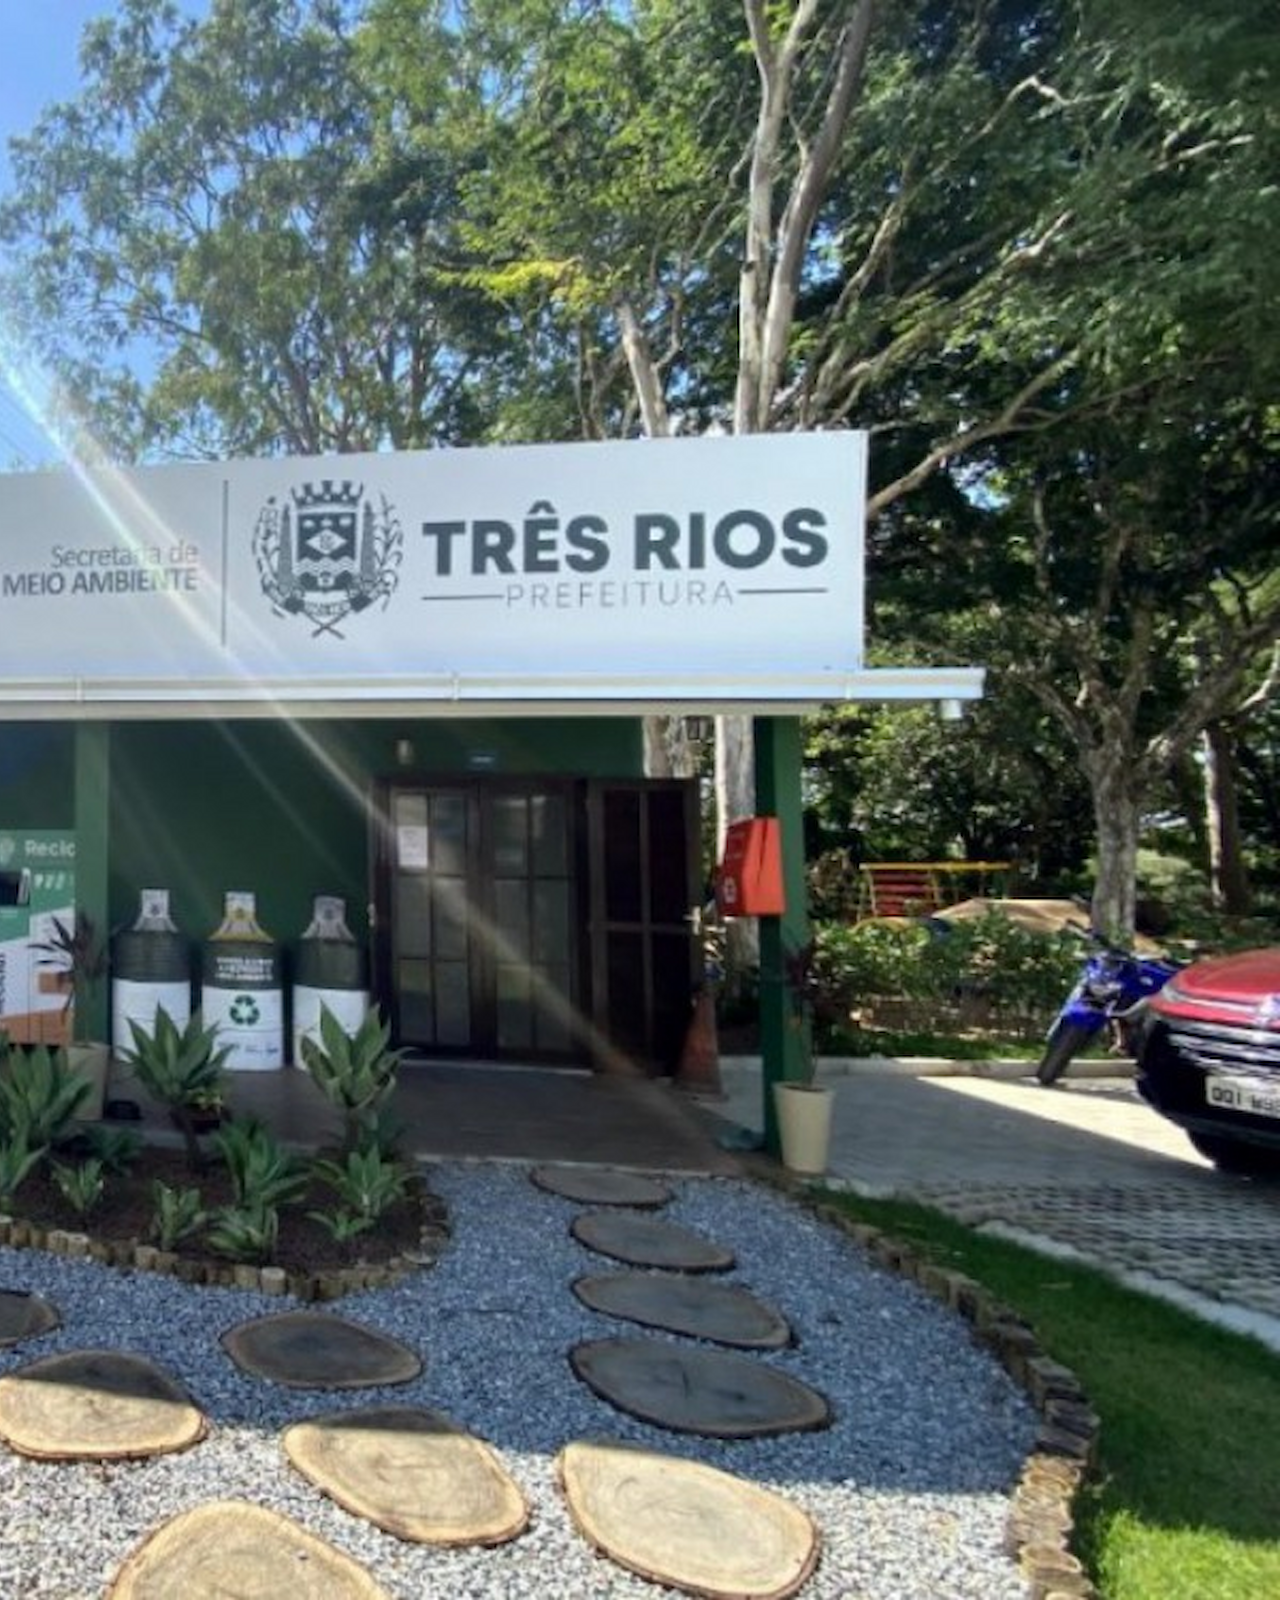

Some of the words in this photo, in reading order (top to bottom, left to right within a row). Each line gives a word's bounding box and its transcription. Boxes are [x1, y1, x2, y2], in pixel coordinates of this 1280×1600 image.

[422, 500, 610, 577] TRÊS
[634, 507, 829, 571] RIOS
[50, 541, 161, 569] Secretaria
[170, 539, 198, 564] de
[2, 570, 64, 597] MEIO
[72, 567, 198, 594] AMBIENTE
[506, 579, 734, 609] PREFEITURA
